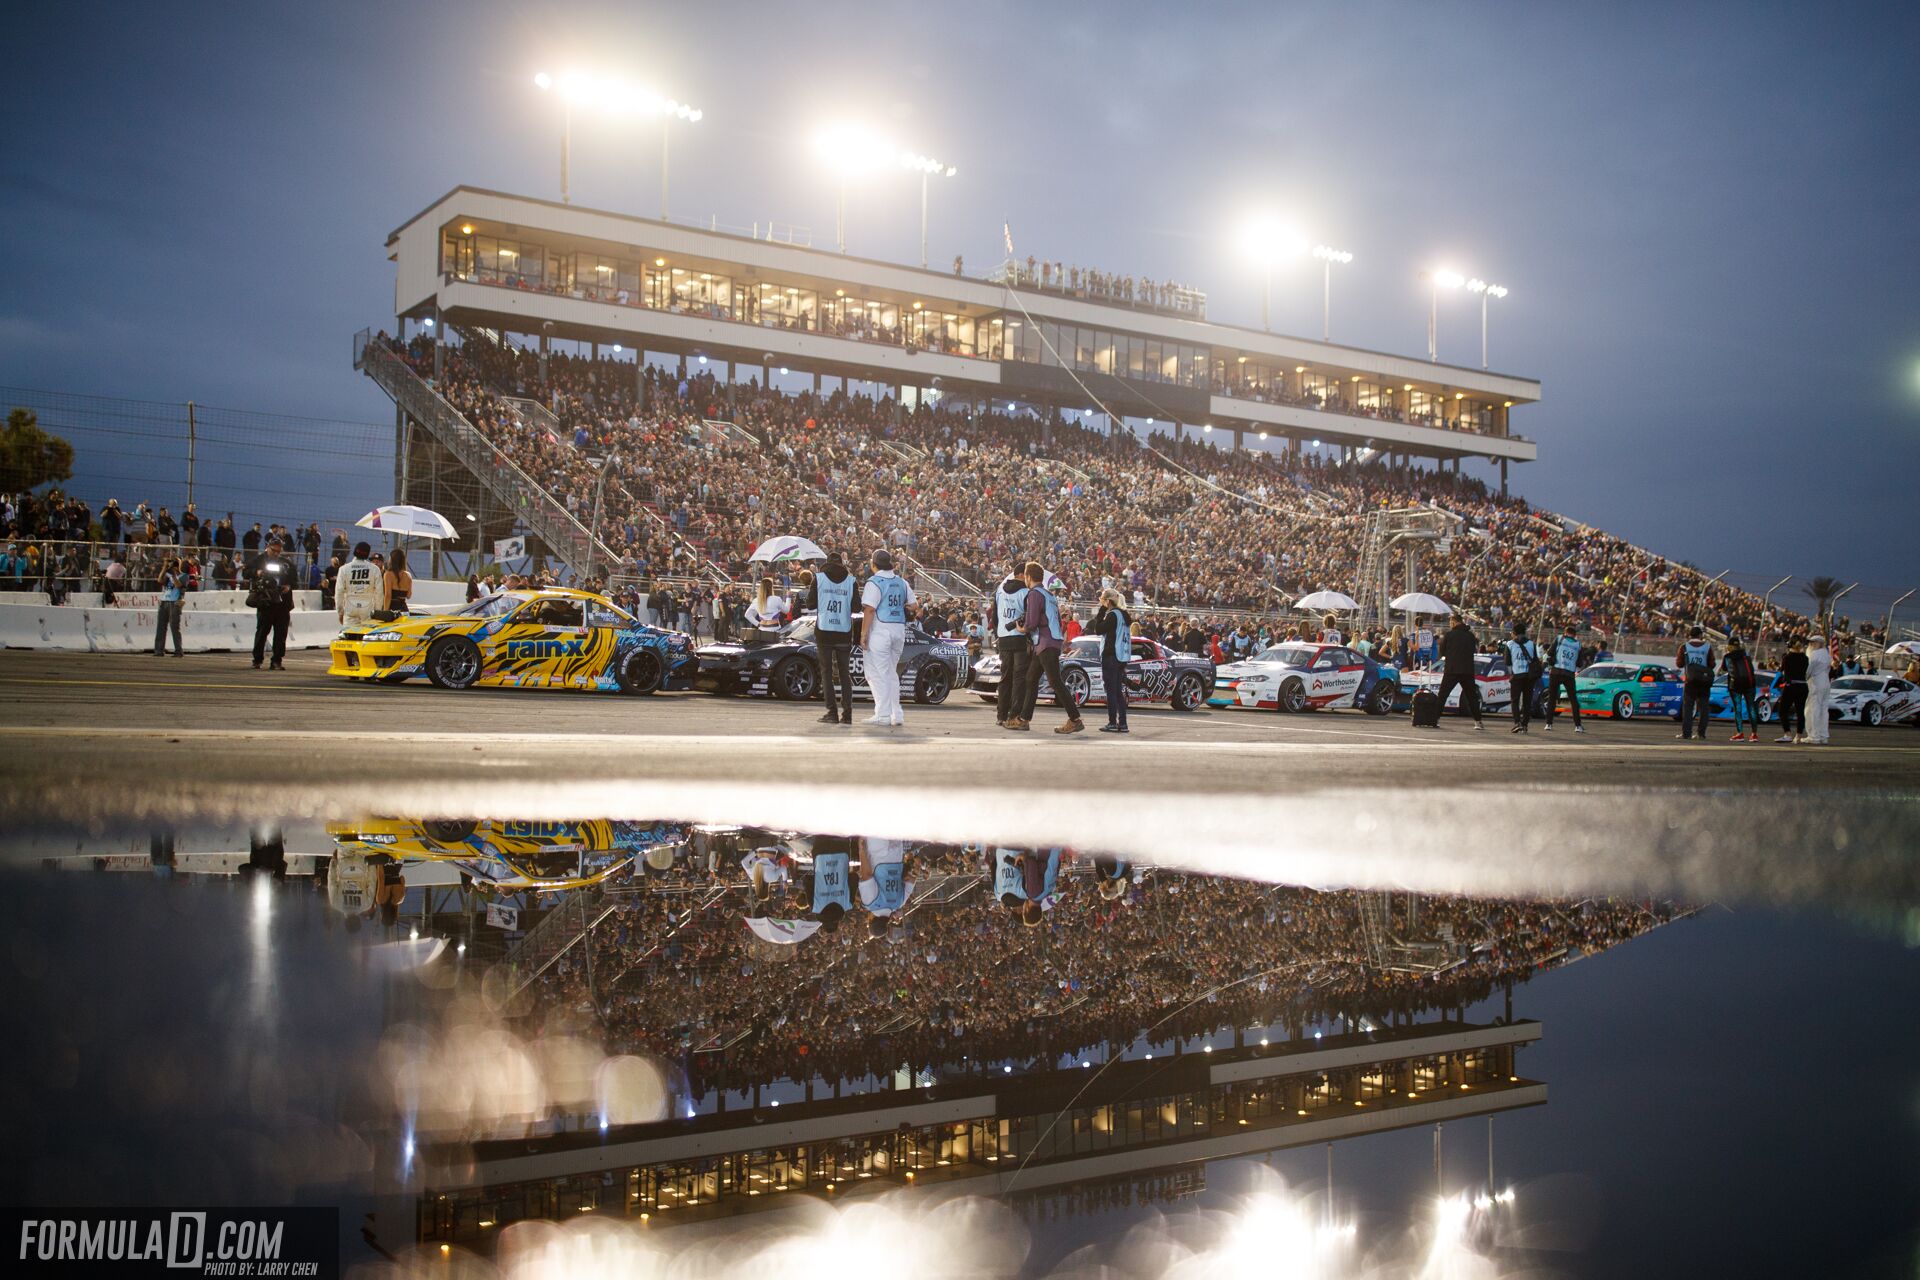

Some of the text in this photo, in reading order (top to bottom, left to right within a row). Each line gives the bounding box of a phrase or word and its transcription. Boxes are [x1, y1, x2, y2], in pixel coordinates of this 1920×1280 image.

[351, 568, 370, 579] 118
[888, 595, 900, 606] 561
[827, 600, 841, 613] 481
[929, 645, 968, 656] Achilles
